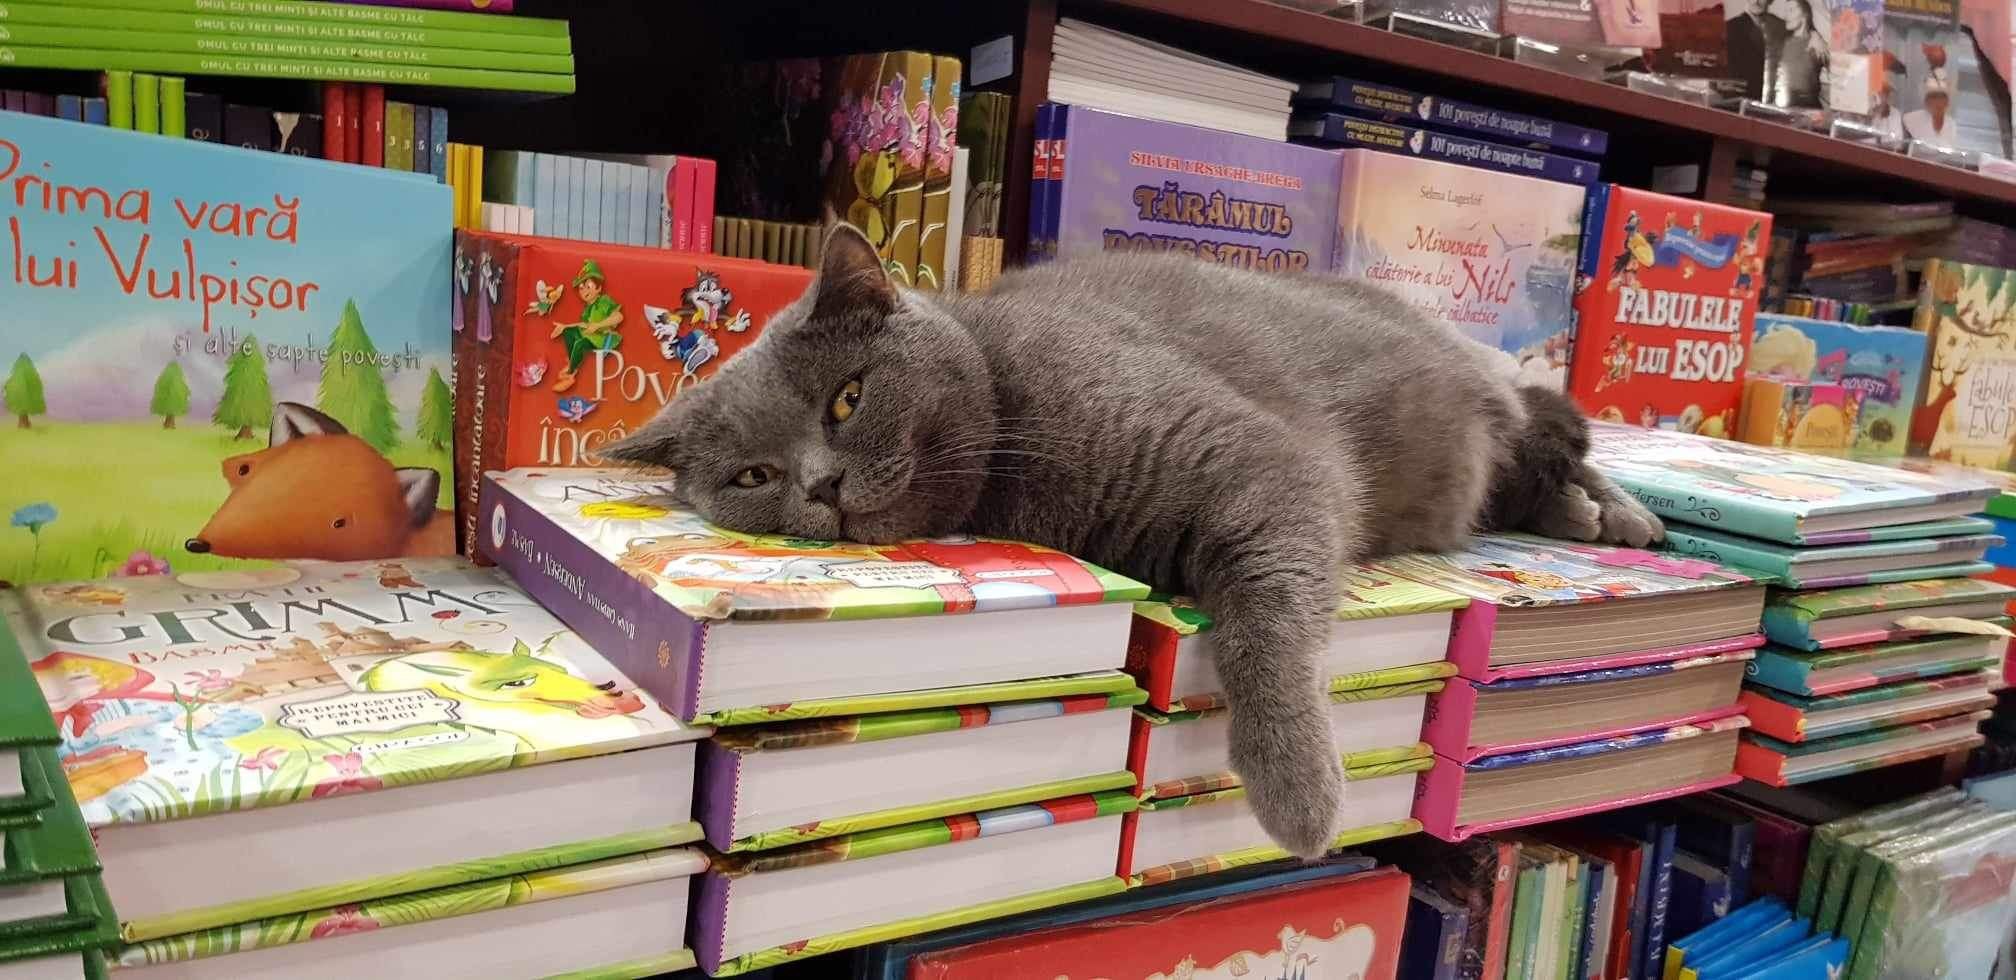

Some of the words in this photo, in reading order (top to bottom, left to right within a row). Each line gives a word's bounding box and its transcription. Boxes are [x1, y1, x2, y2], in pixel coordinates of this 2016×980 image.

[196, 0, 225, 10] OMUL
[230, 2, 245, 11] CU
[249, 3, 273, 13] TREI
[320, 7, 345, 17] ALTE
[347, 9, 380, 20] BASME
[383, 12, 397, 22] CU
[195, 18, 226, 30] OMUL
[230, 21, 244, 31] CU
[248, 22, 272, 33] TREI
[320, 26, 345, 37] ALTE
[347, 28, 380, 39] BASME
[383, 31, 397, 40] CU
[197, 39, 228, 50] OMUL
[232, 41, 247, 51] CU
[250, 42, 274, 53] TREI
[322, 46, 347, 57] ALTE
[350, 47, 383, 59] BASME
[386, 50, 400, 59] CU
[200, 60, 232, 71] OMUL
[236, 62, 250, 72] CU
[253, 63, 277, 74] TREI
[325, 66, 349, 76] ALTE
[352, 67, 386, 79] BASME
[389, 70, 402, 80] CU
[1439, 102, 1453, 119] 101
[1488, 111, 1500, 127] de
[1130, 151, 1181, 170] SILVIA
[1431, 136, 1445, 152] 101
[1480, 145, 1492, 160] de
[174, 193, 301, 244] vară
[1133, 180, 1293, 239] TĂRÂMUL
[1407, 225, 1489, 258] Minunata
[9, 216, 77, 288] lui
[93, 225, 320, 333] Vulpișor
[1423, 271, 1432, 285] a
[1435, 260, 1456, 287] lui
[1453, 258, 1516, 304] Nils
[1615, 286, 1744, 333] FABULELE
[205, 325, 253, 356] alte
[1634, 345, 1670, 374] LUI
[1670, 338, 1744, 383] ESOP
[1632, 488, 1675, 509] dersen
[542, 551, 587, 600] ANDERSEN
[46, 589, 512, 646] GRIMM
[298, 694, 428, 714] REPOVESTITE
[313, 705, 389, 721] PENTRU
[395, 702, 425, 713] CEI
[335, 717, 371, 727] MAI
[376, 711, 417, 722] MICI
